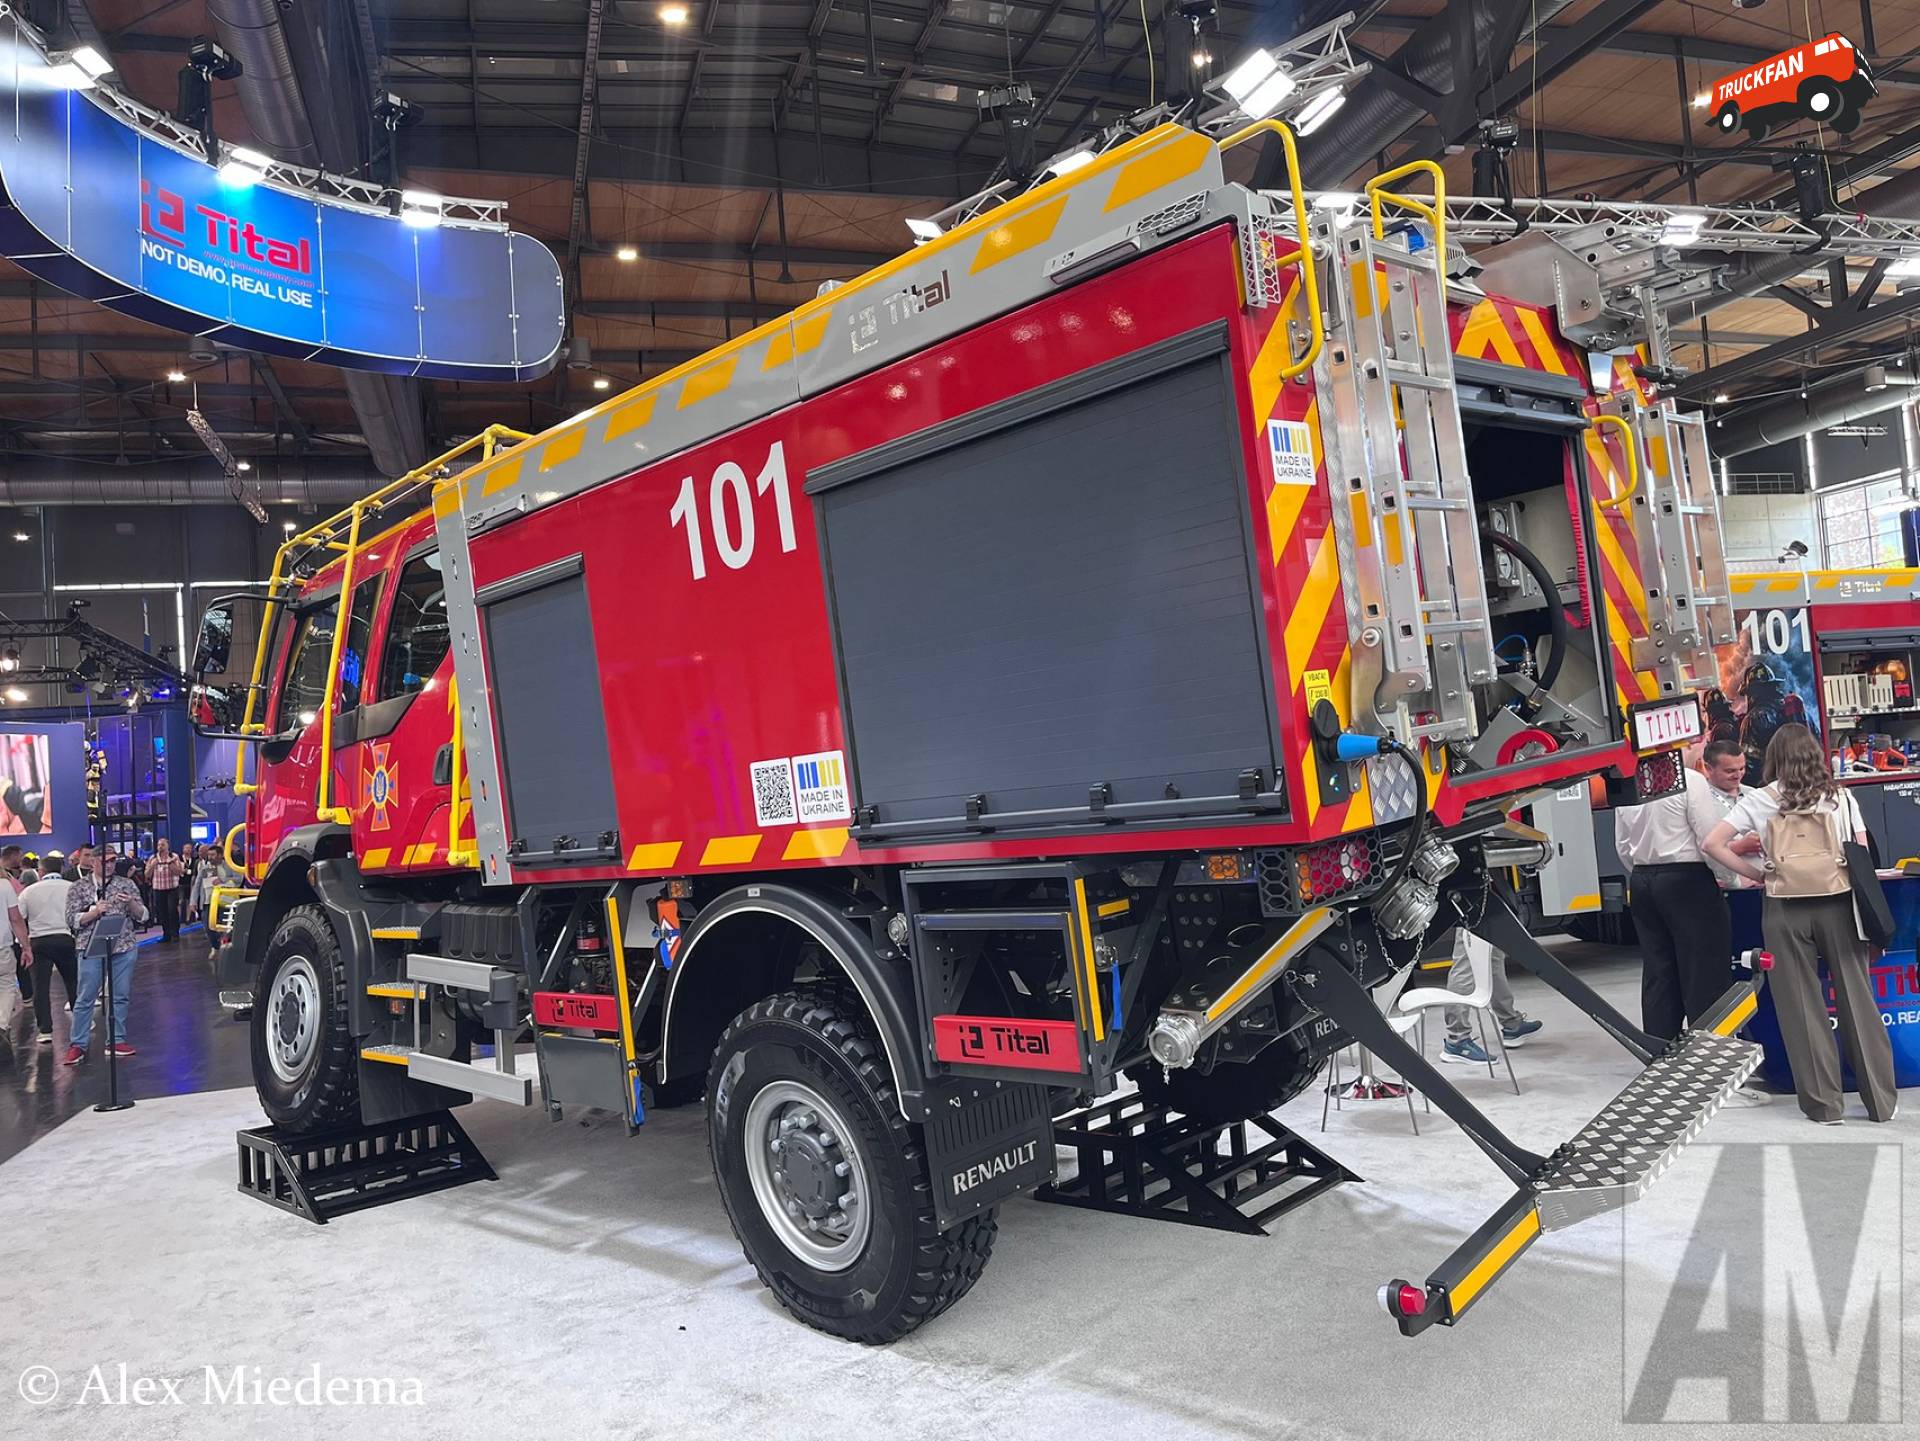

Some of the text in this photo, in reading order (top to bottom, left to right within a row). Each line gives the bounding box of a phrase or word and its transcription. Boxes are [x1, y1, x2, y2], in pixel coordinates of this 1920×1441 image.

[196, 205, 311, 275] Tital
[141, 239, 313, 309] NOT DEMO. REAL USE
[882, 269, 951, 325] Tital
[1275, 455, 1311, 466] MADE IN
[1276, 467, 1312, 478] UKRAINE
[670, 440, 797, 580] 101
[1741, 607, 1812, 656] 101
[1646, 709, 1691, 742] TITAL
[800, 788, 844, 803] MADE IN
[802, 801, 845, 816] UKRAINE
[567, 999, 598, 1019] Tital
[989, 1027, 1050, 1055] Tital
[952, 1140, 1037, 1195] RENAULT
